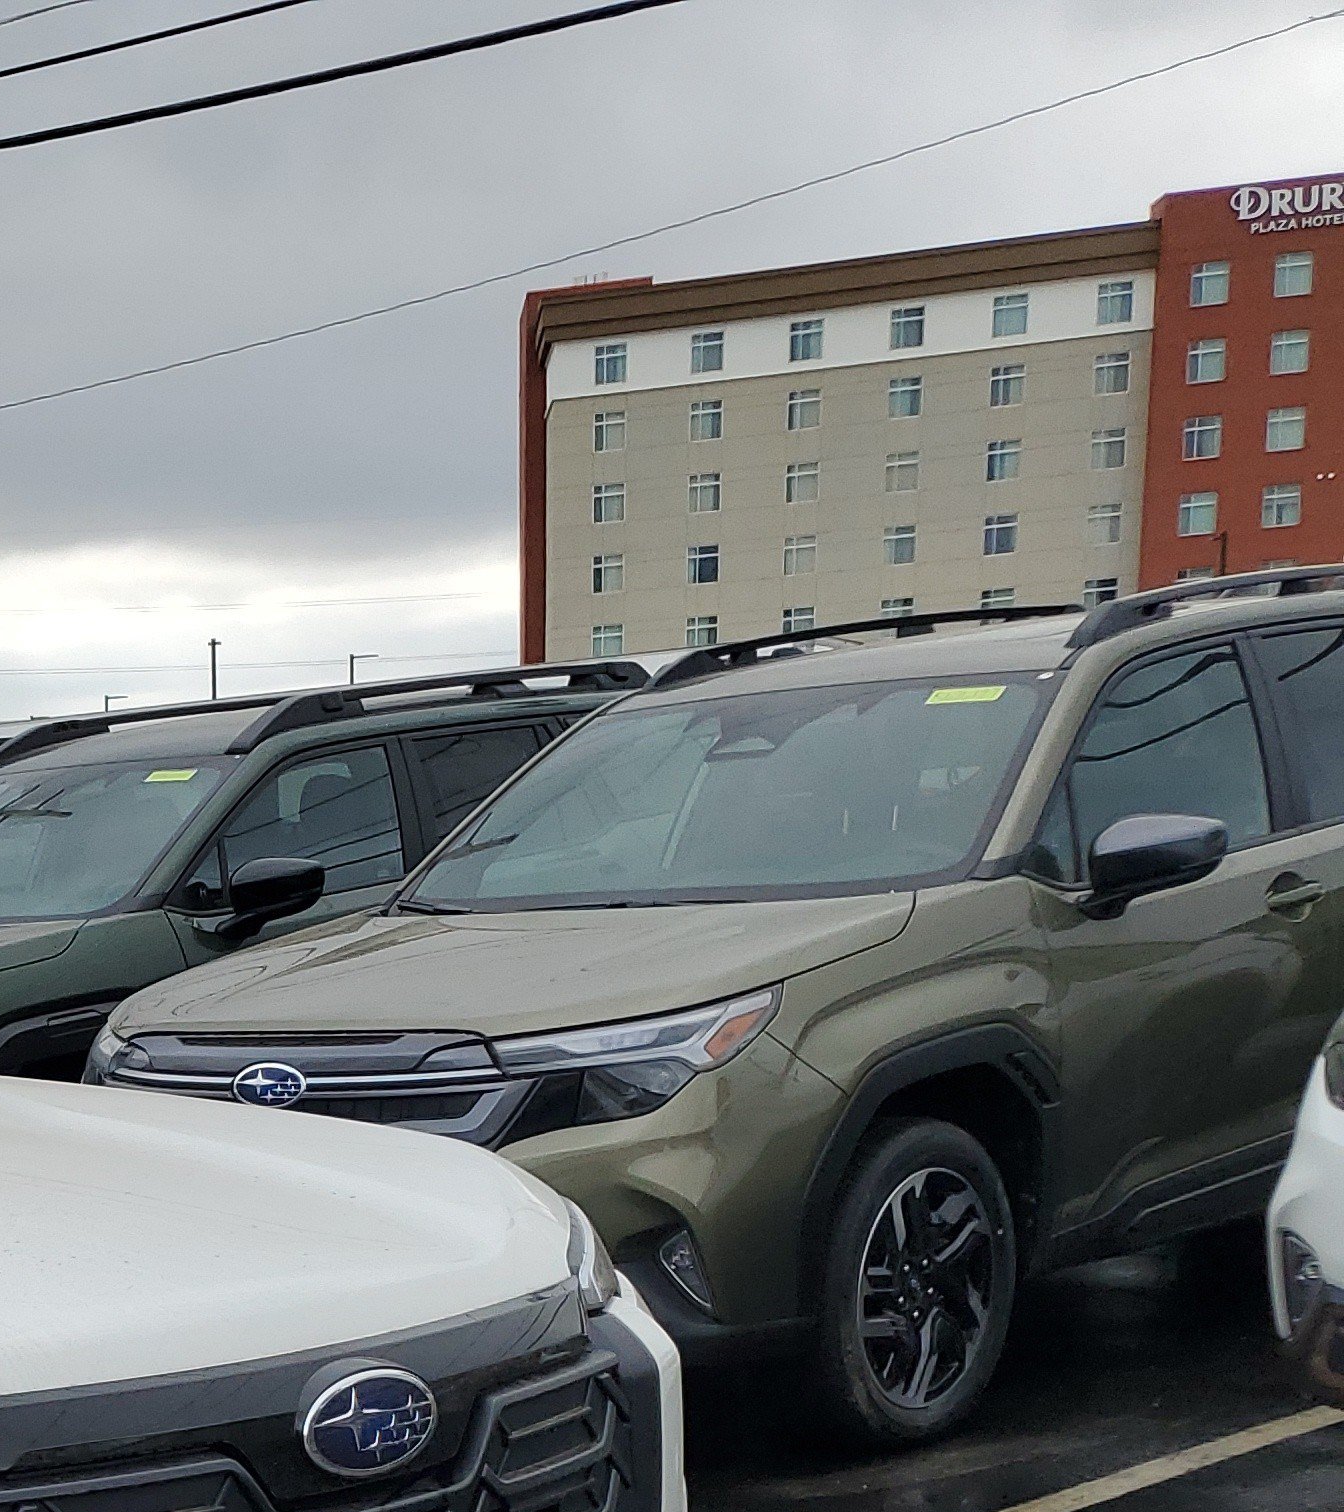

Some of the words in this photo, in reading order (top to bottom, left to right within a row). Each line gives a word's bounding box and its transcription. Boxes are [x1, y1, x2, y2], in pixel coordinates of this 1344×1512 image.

[1230, 182, 1344, 220] DRUR
[1250, 219, 1298, 234] PLAZA
[1301, 213, 1344, 229] HOTE
